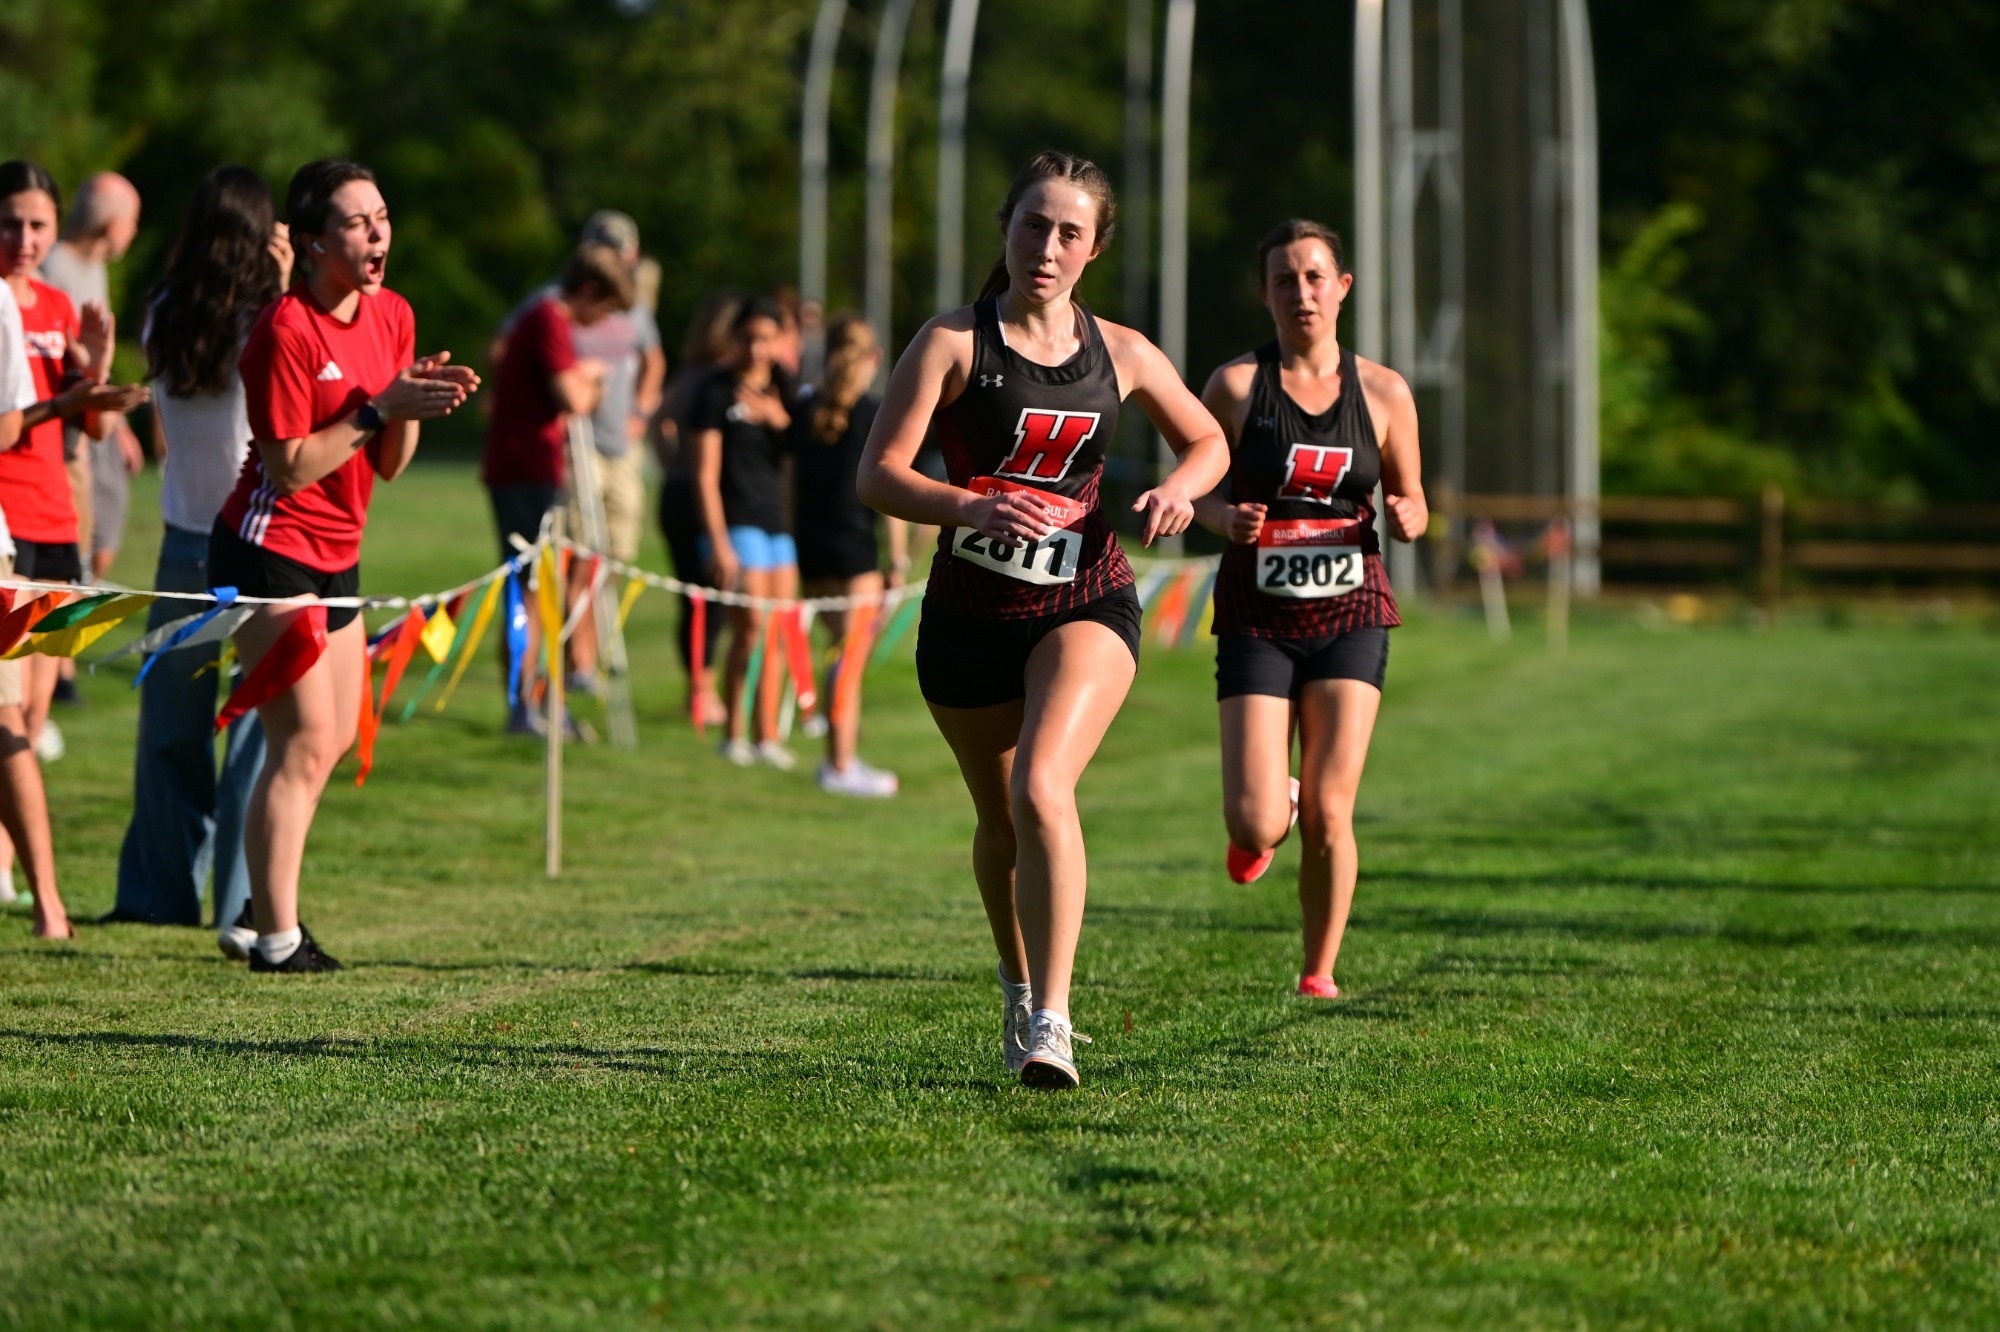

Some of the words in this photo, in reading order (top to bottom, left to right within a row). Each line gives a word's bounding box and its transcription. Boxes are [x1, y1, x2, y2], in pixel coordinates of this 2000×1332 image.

[994, 407, 1101, 482] H
[1276, 443, 1353, 505] H
[1272, 529, 1300, 540] RACE
[1265, 553, 1355, 587] 2802
